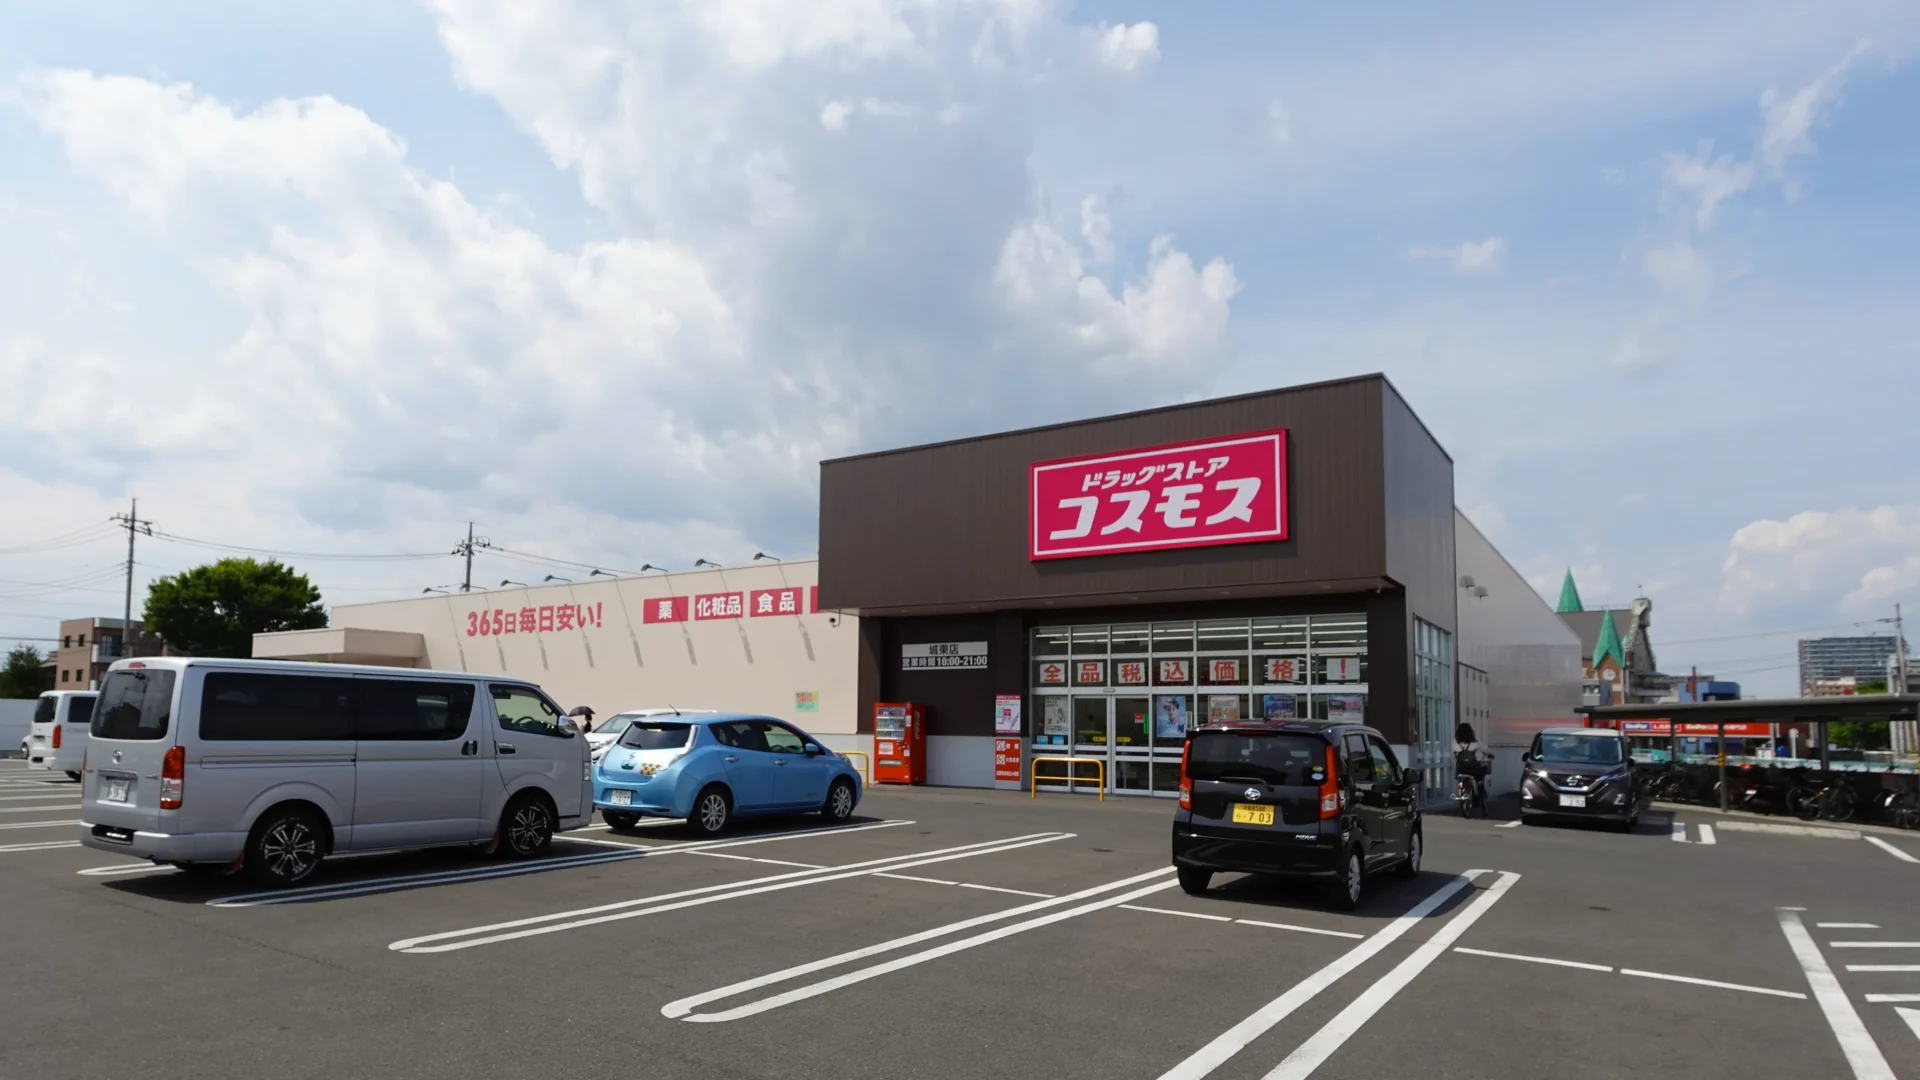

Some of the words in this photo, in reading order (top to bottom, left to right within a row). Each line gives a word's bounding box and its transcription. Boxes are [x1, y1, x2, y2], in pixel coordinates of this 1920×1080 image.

[1081, 456, 1230, 492] ドラッグストア
[1049, 477, 1262, 541] コスモス
[658, 600, 673, 620] 薬
[697, 595, 742, 617] 化粧品
[757, 591, 796, 614] 食品
[929, 644, 959, 655] 城東店
